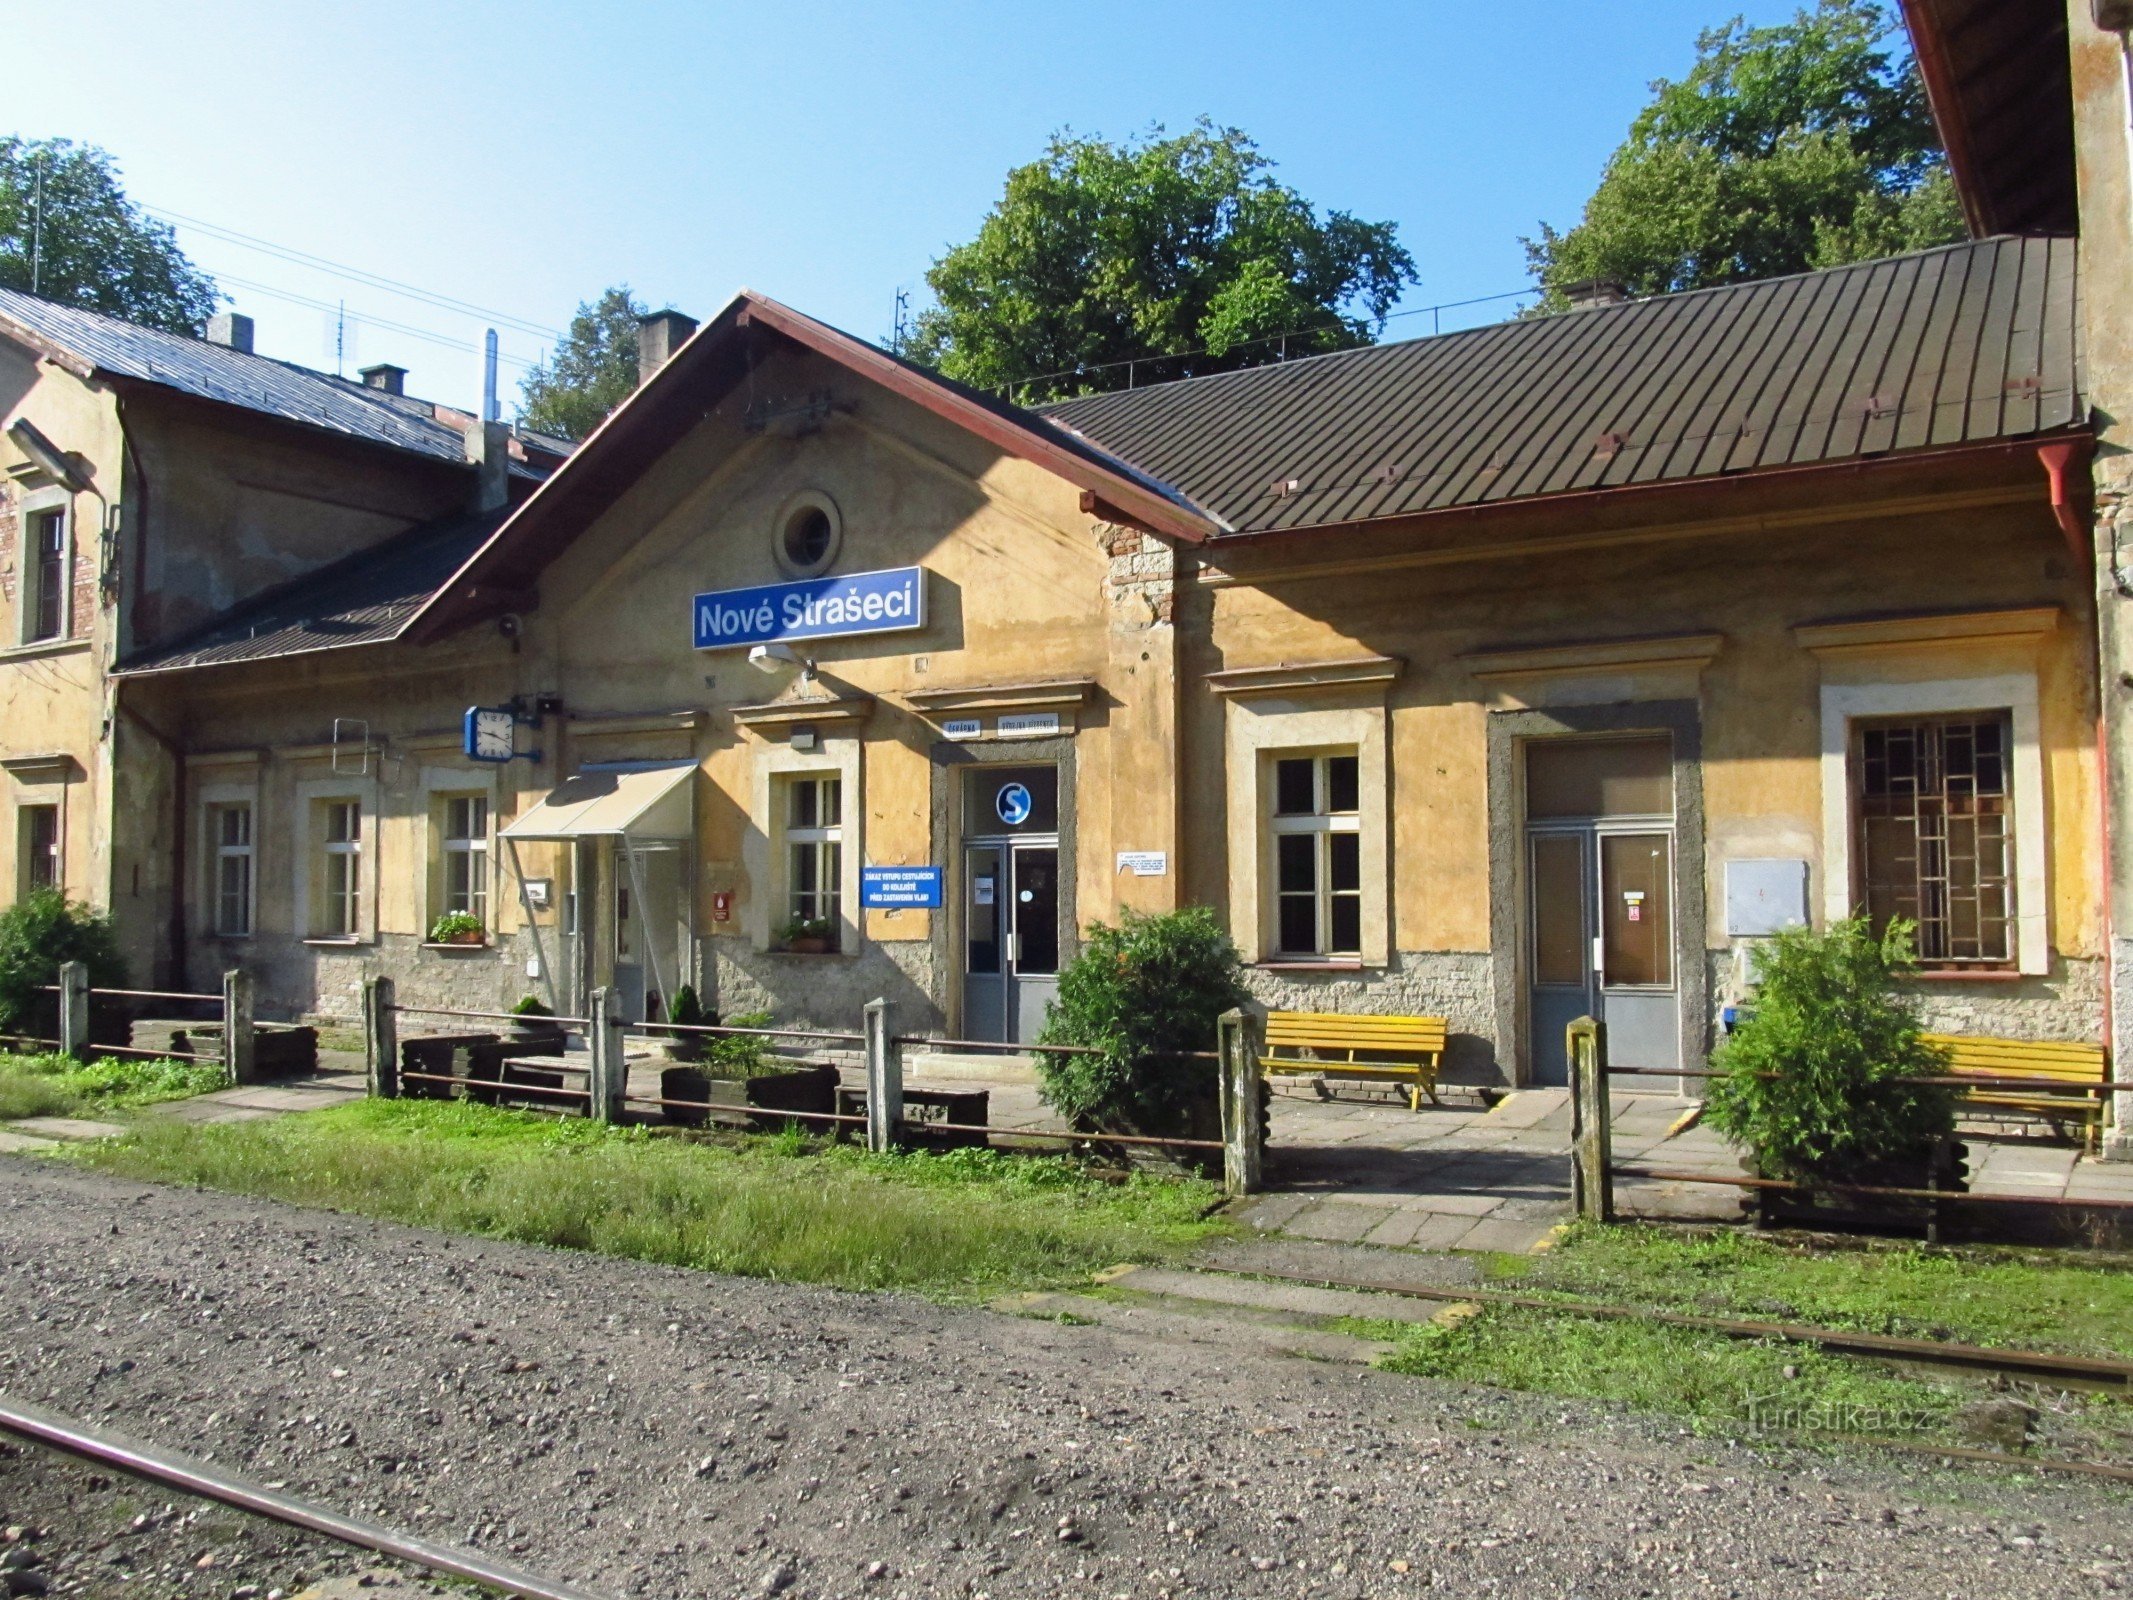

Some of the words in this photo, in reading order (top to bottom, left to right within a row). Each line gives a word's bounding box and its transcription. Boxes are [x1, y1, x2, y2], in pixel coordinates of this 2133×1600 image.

[701, 598, 774, 638] Nové
[782, 581, 911, 629] Strašecí
[948, 723, 975, 734] ČEKÁRNA
